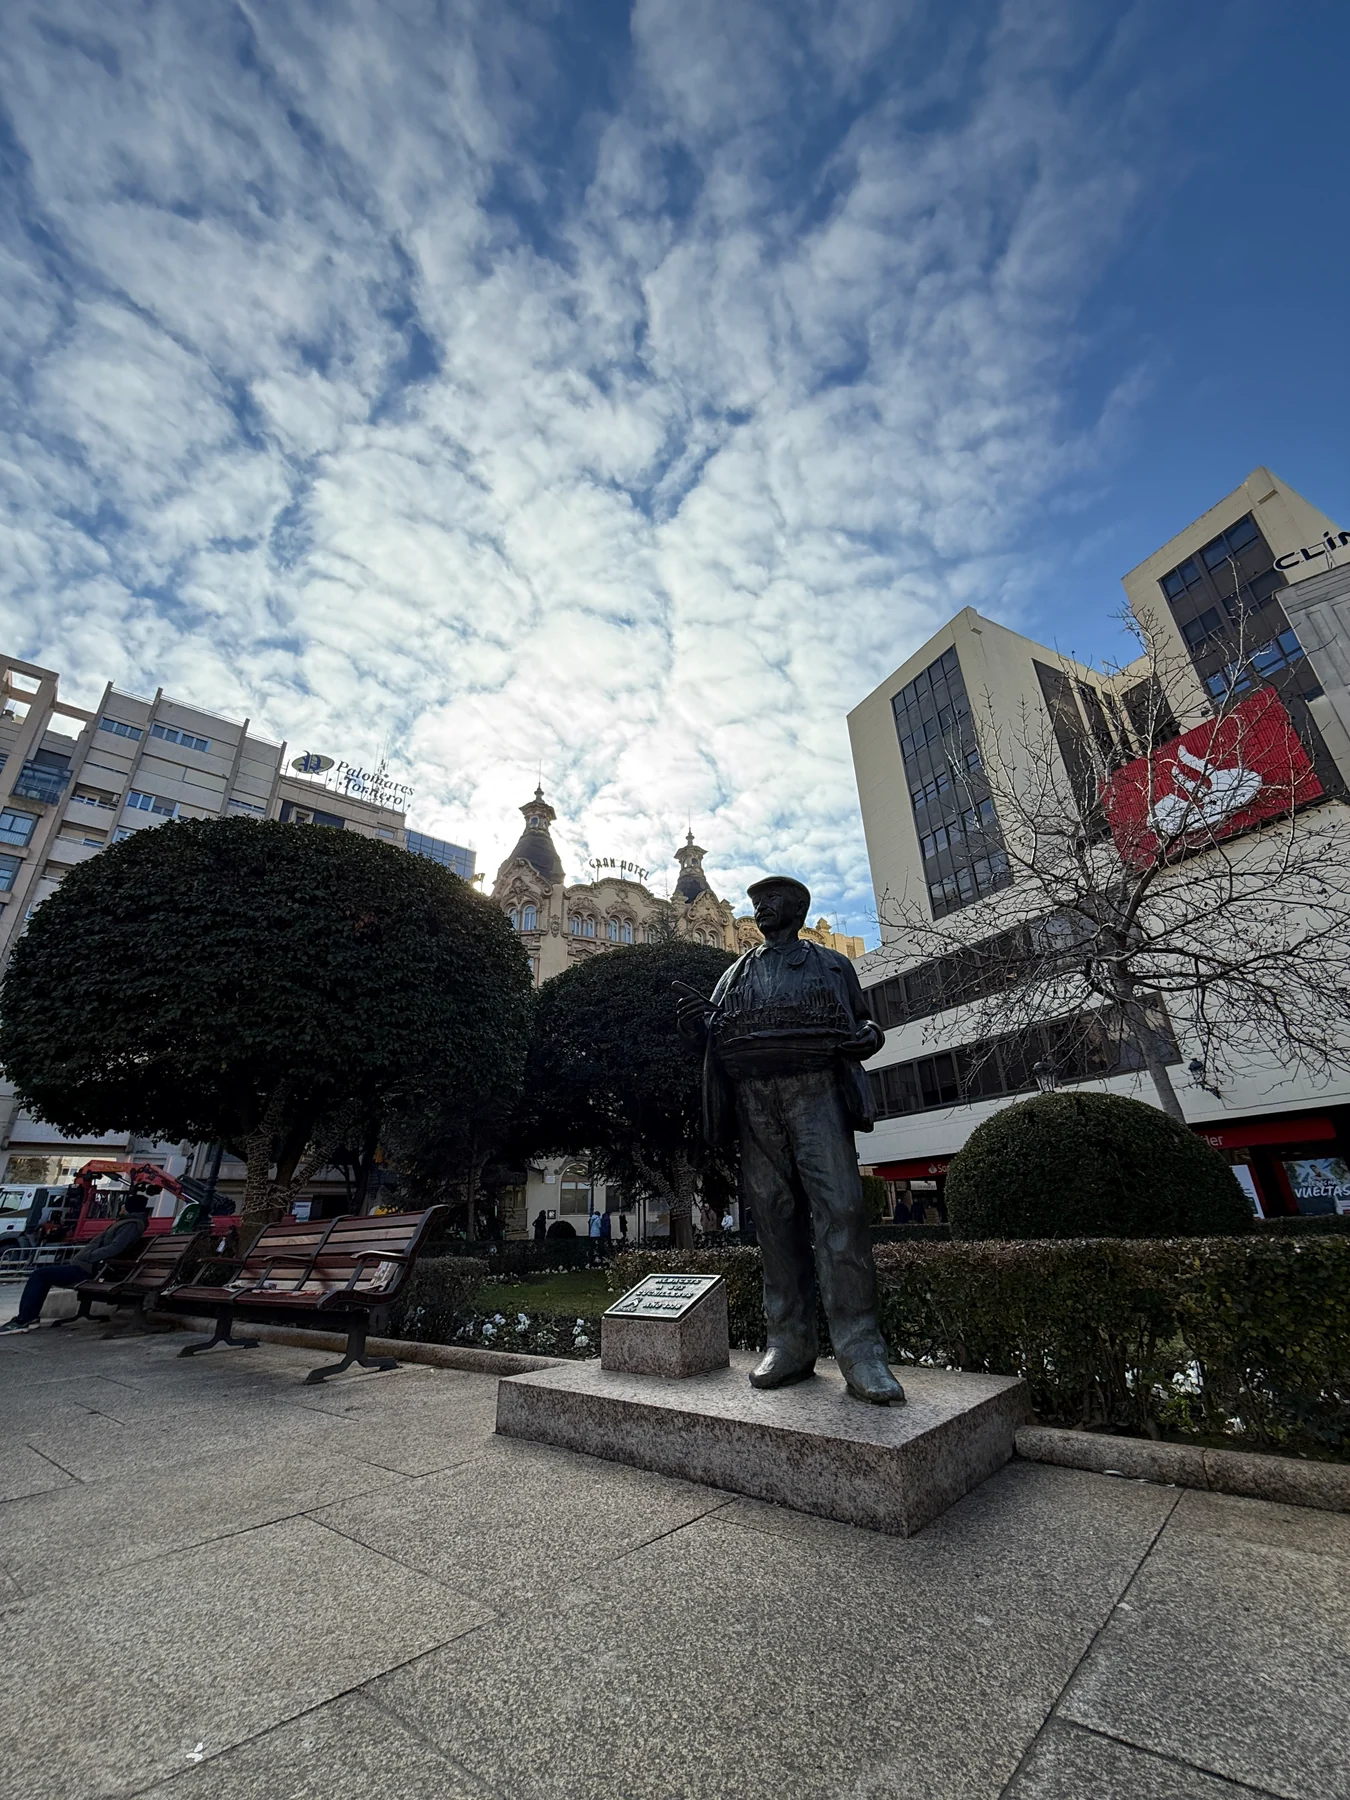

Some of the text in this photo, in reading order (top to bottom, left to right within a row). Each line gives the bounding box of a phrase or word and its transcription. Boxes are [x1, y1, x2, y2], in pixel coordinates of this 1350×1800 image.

[336, 760, 416, 797] Palomares
[343, 775, 404, 806] Tornero
[588, 857, 650, 881] GRAN HOTEL
[1294, 1184, 1350, 1199] VUELTAS
